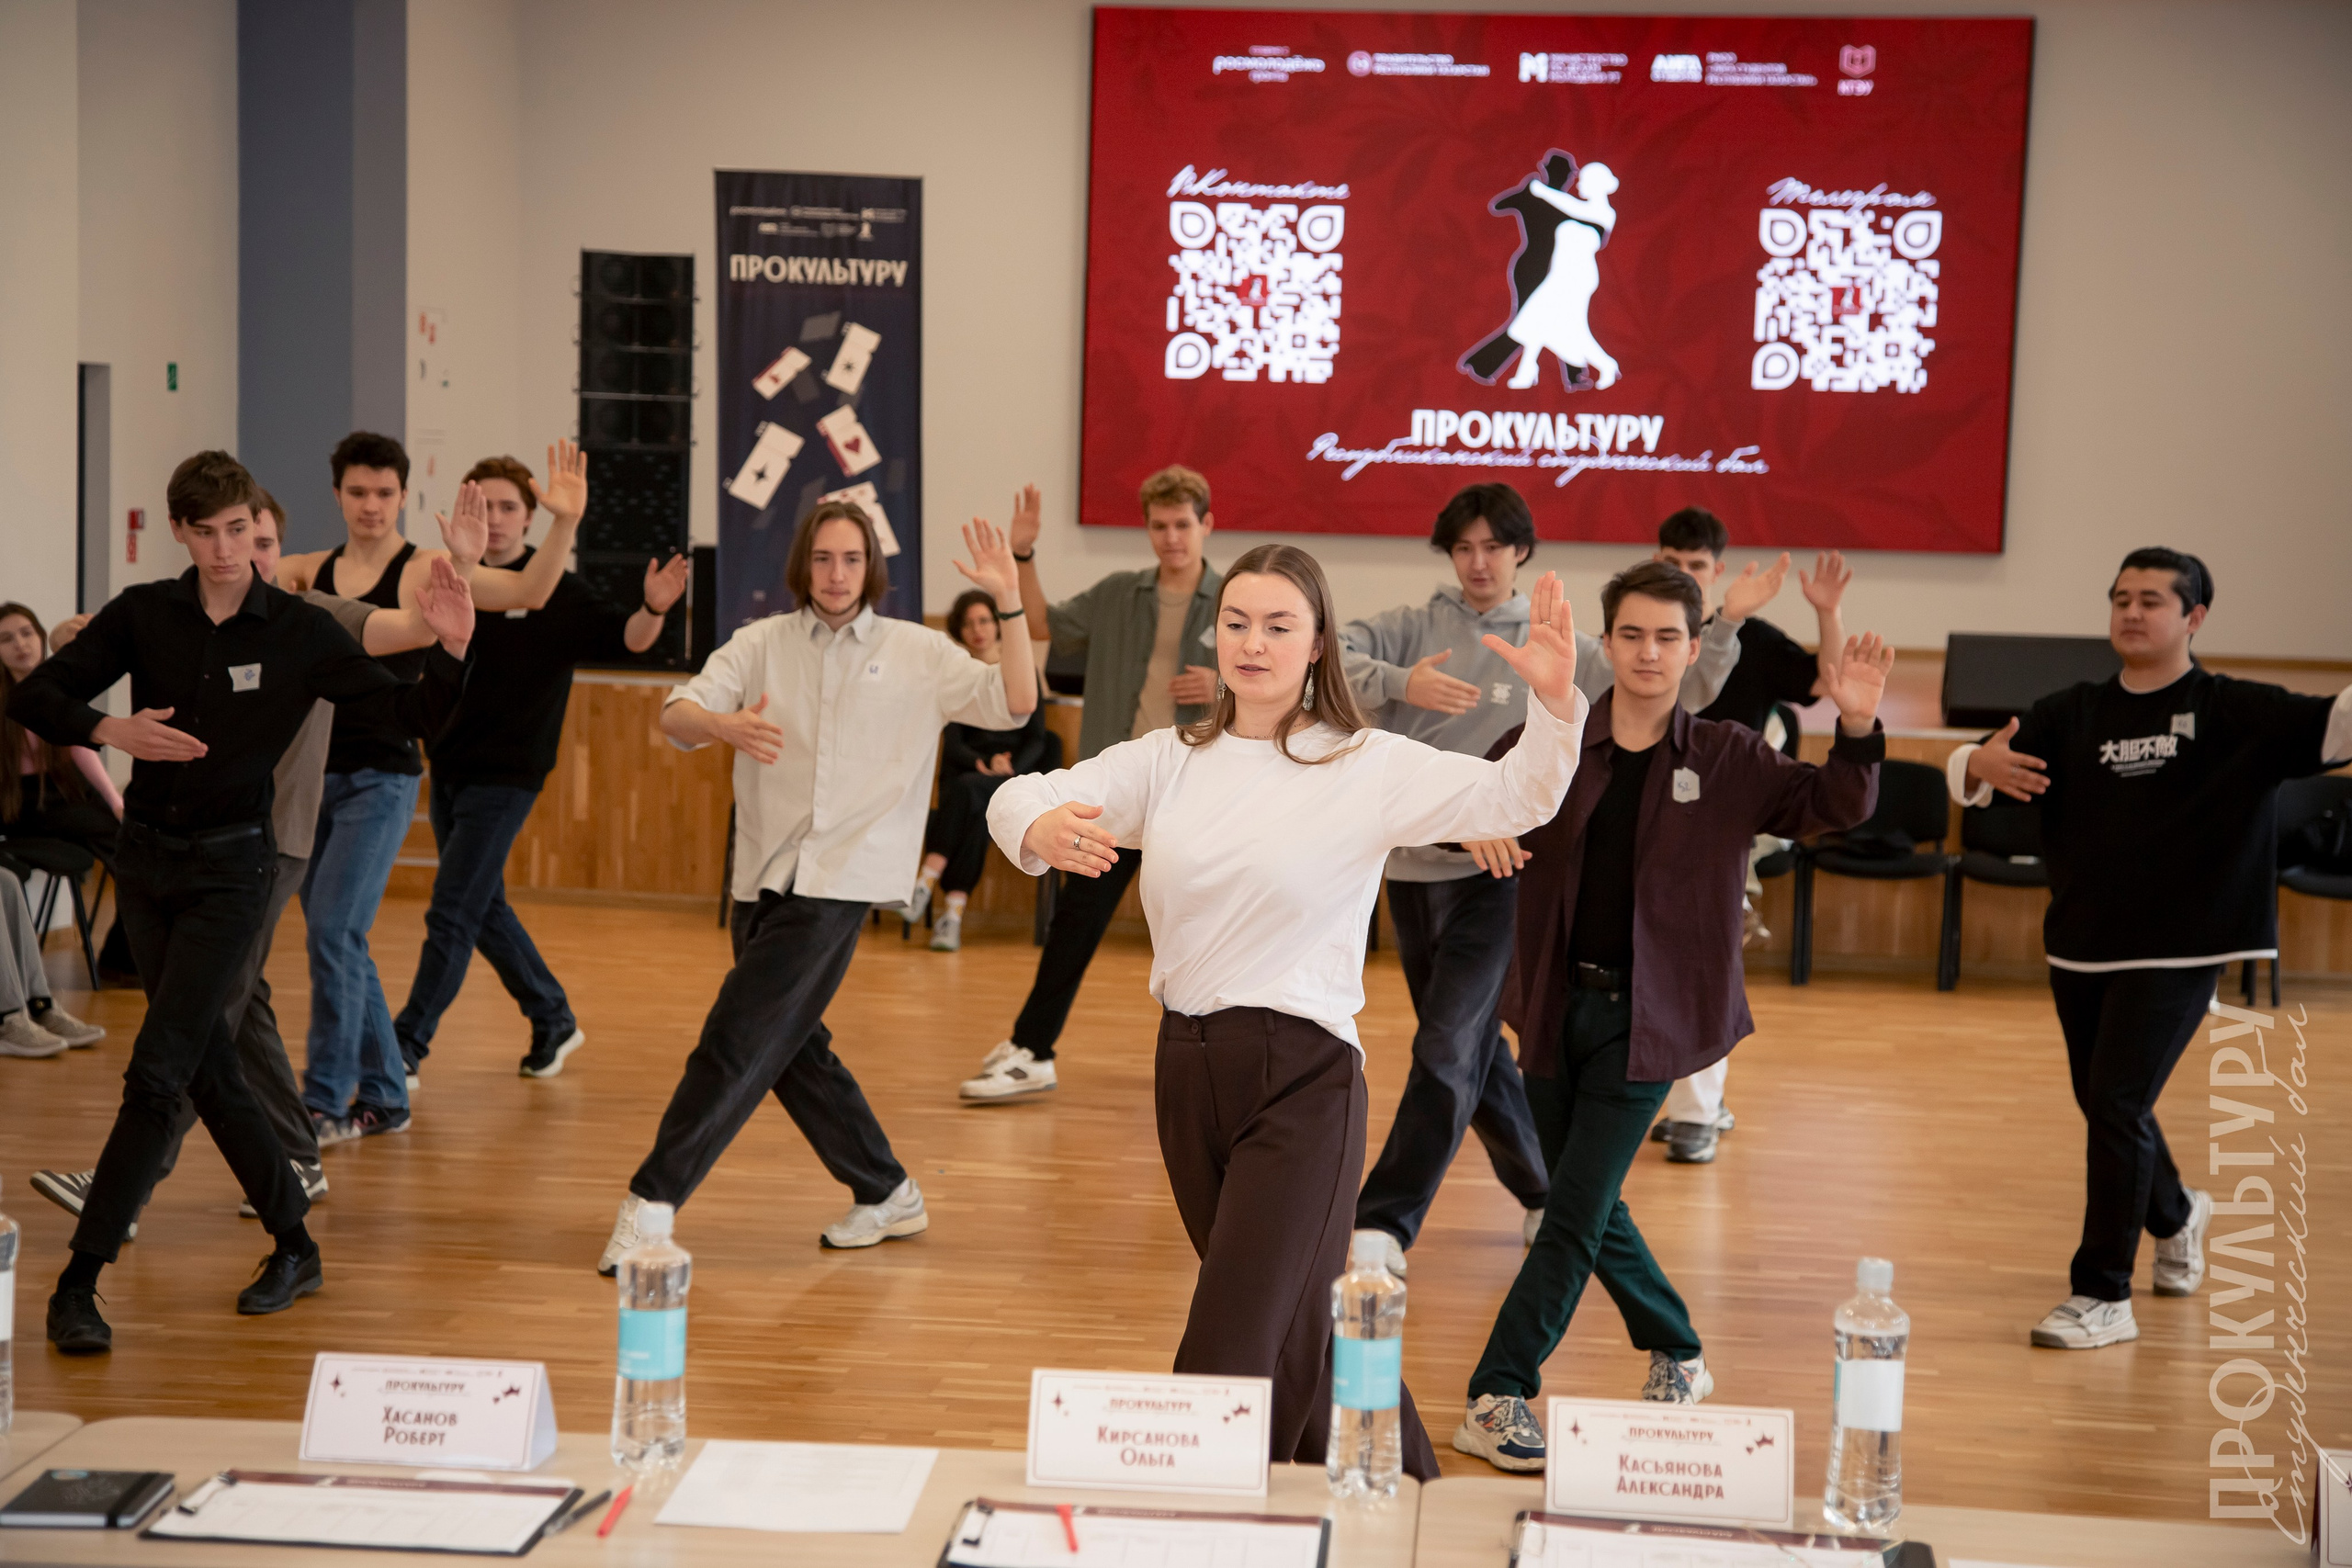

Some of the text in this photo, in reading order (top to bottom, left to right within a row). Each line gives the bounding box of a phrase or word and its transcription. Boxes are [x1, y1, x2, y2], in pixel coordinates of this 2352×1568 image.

[729, 254, 909, 288] ПРОКУЛЬТУРУ
[1410, 408, 1665, 453] ПРОКУЛЬТУРУ
[385, 1380, 465, 1393] ПРОКУЛЬТУРУ
[1109, 1397, 1193, 1413] ПРОКУЛЬТУРУ
[1629, 1427, 1714, 1442] ПРОКУЛЬТУРУ
